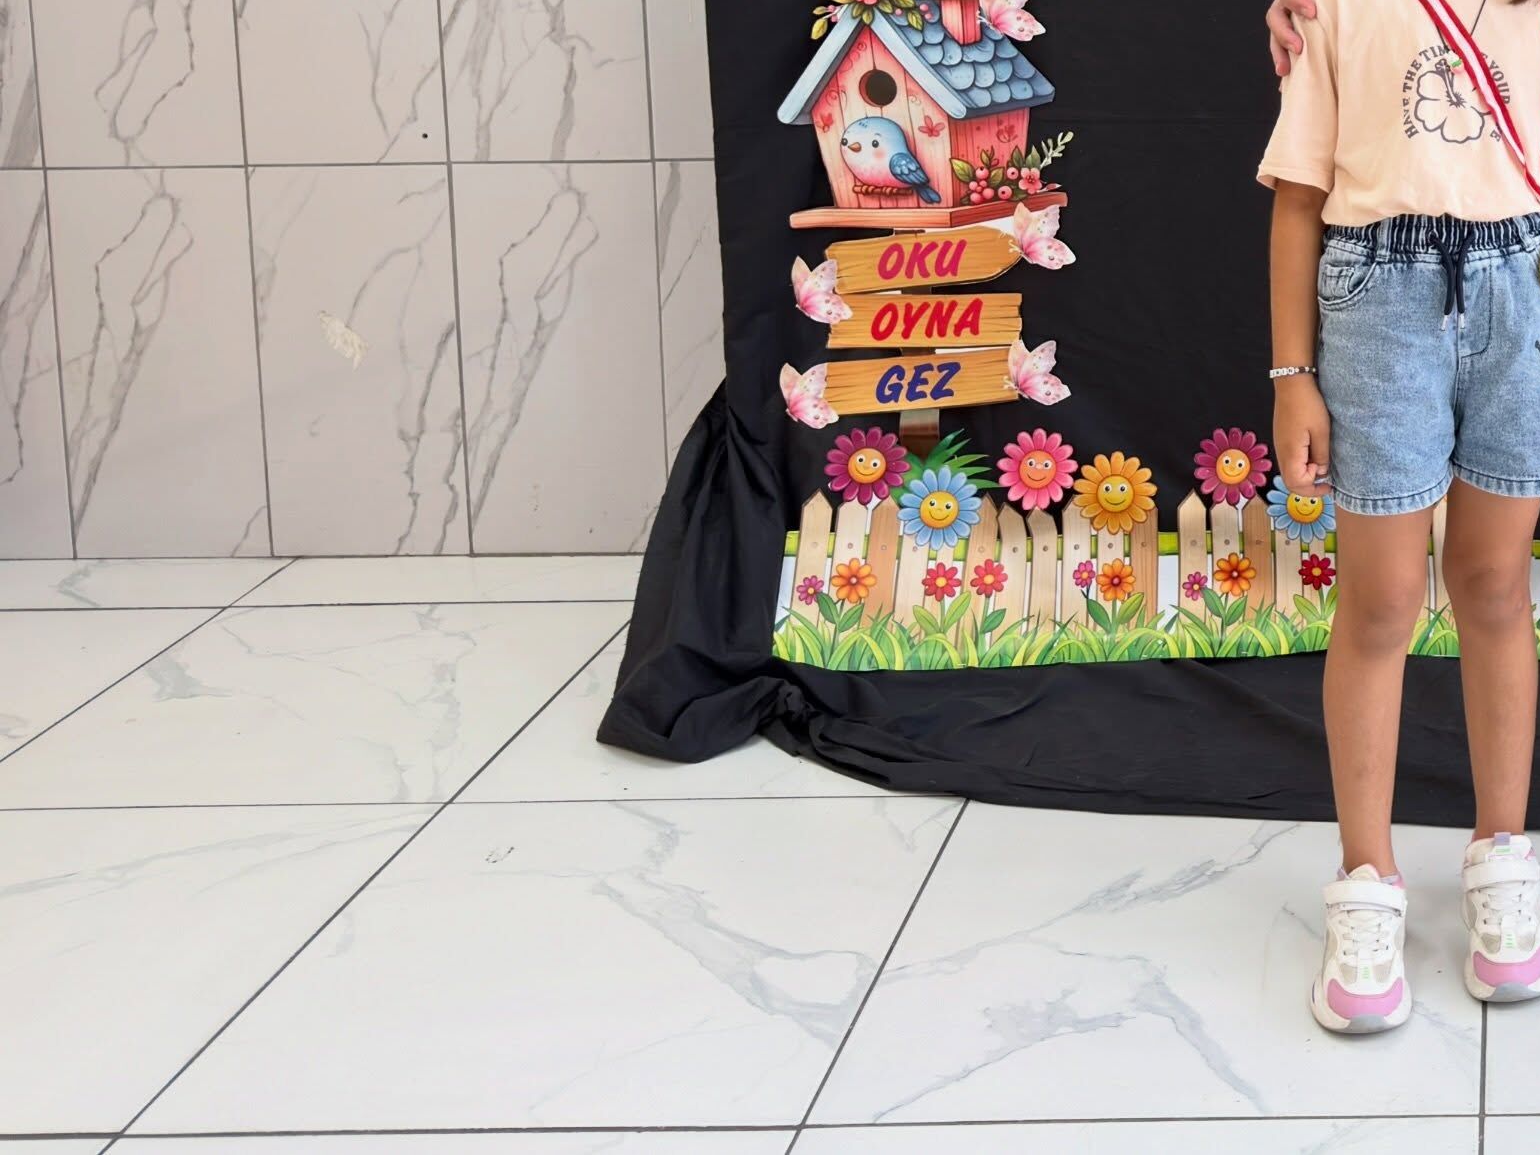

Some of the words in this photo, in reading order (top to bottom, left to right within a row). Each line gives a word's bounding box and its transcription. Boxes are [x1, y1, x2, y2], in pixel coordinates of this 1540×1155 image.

[1402, 58, 1423, 93] THE
[1402, 97, 1420, 139] HAVE
[876, 238, 968, 281] OKU
[870, 297, 984, 342] OYNA
[874, 360, 962, 405] GEZ
